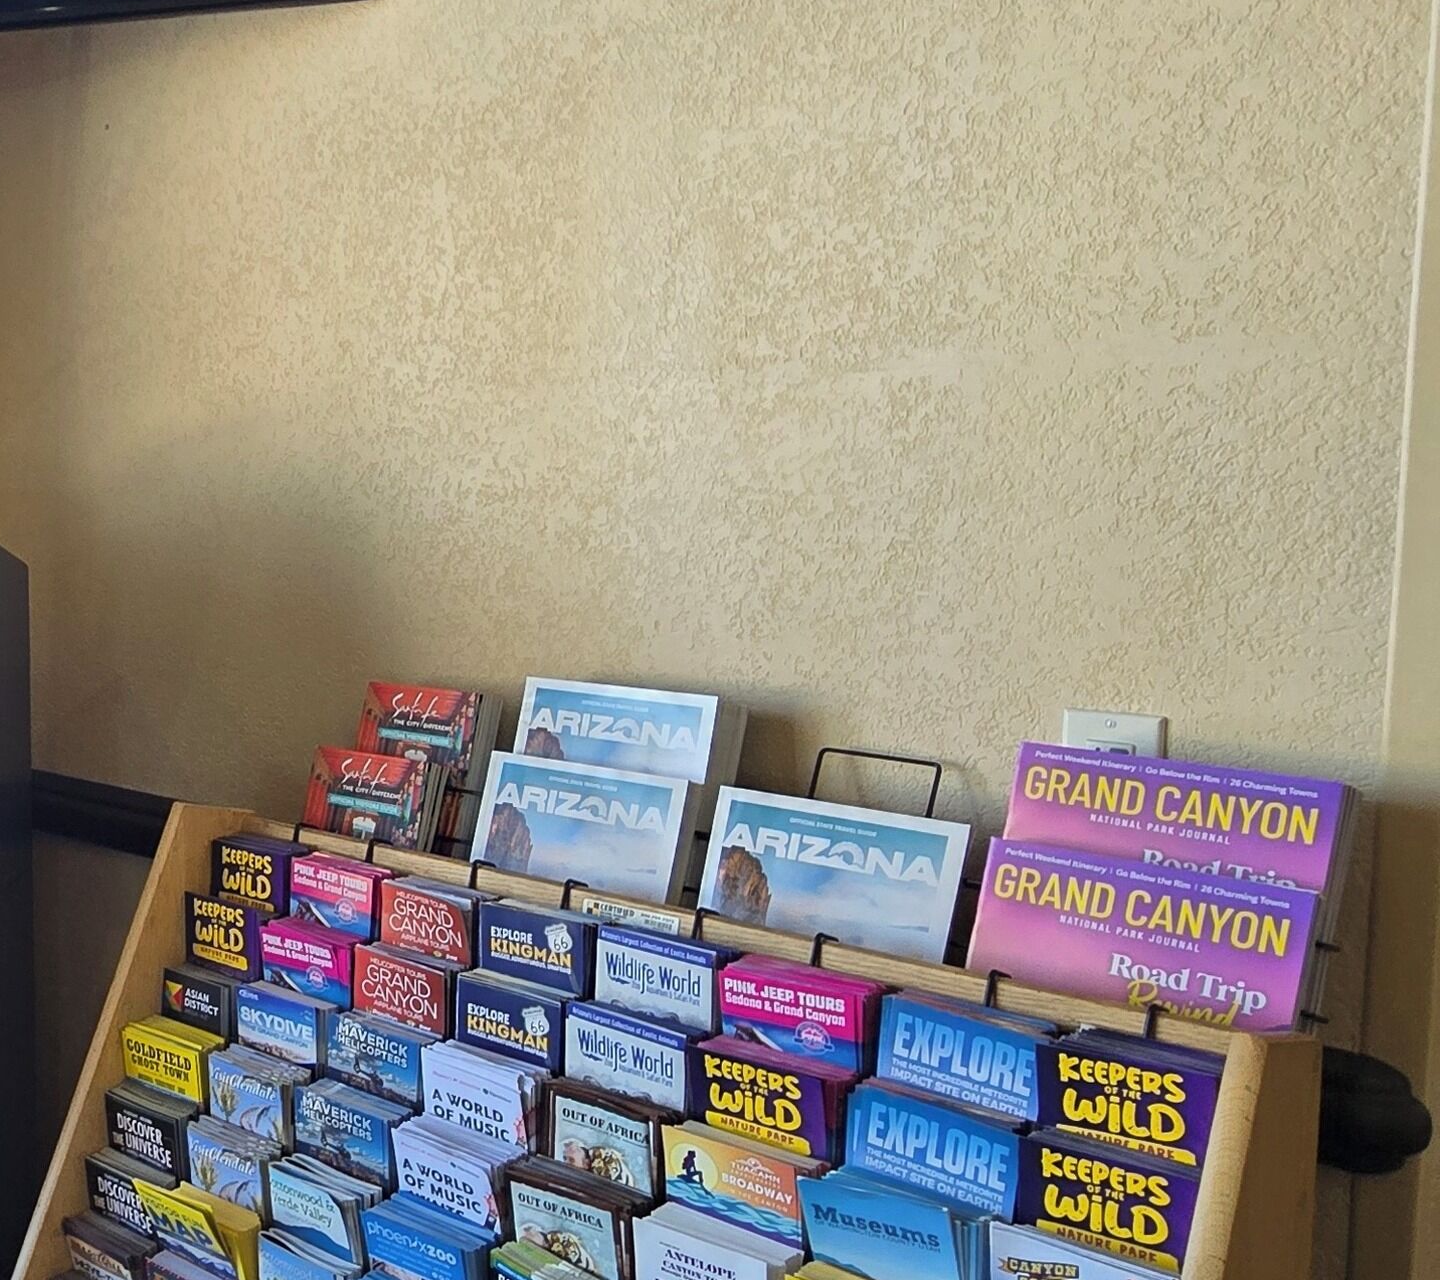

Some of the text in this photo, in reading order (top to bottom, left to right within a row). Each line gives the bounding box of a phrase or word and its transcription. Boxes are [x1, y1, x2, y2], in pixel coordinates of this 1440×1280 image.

[406, 720, 420, 728] CITY
[526, 706, 697, 750] ARIZONA
[1035, 750, 1136, 773] Perfect Weekend Itinerary
[1145, 765, 1220, 784] Go Below Rim
[1230, 777, 1318, 798] 26 Charming Towns
[496, 782, 664, 833] ARIZONA
[1024, 766, 1319, 845] GRAND CANYON
[1090, 814, 1231, 845] NATIONAL PARK JOURNAL
[222, 846, 272, 873] KEEPERS
[722, 823, 940, 885] ARIZONA
[317, 867, 341, 884] JEEP
[193, 898, 244, 927] KEEPERS
[394, 898, 453, 928] GRAND
[994, 863, 1291, 957] GRAND CANYON
[389, 914, 462, 948] CANYON
[491, 926, 569, 951] EXPLORE 66
[1060, 915, 1200, 952] NATIONAL PARK JOURNAL
[491, 938, 571, 970] KINGMAN
[367, 965, 431, 998] GRAND
[605, 951, 655, 992] Wildlife
[659, 967, 701, 997] World
[1109, 953, 1267, 1014] Road Trip
[184, 998, 219, 1017] DISTRICT
[185, 988, 209, 1002] ASIAN
[361, 980, 437, 1019] CANYON
[726, 993, 761, 1008] Sedona
[797, 992, 845, 1012] TOURS
[239, 1006, 313, 1039] SKYDIVE
[467, 1003, 509, 1025] EXPLORE
[338, 1017, 408, 1059] MAVERICK
[467, 1015, 548, 1051] KINGMAN
[127, 1039, 191, 1070] GOLDFIELD
[338, 1033, 407, 1069] HELICOPTERS
[631, 1047, 673, 1080] World
[893, 1012, 1035, 1097] EXPLORE
[162, 1066, 190, 1082] TOWN
[705, 1054, 801, 1100] KEEPERS
[908, 1063, 1028, 1108] MOST INCREDIBLE METEORITE
[1059, 1053, 1185, 1103] KEEPERS
[432, 1089, 503, 1122] A WORLD
[891, 1068, 1028, 1118] IMPACT SITE ON EARTH!
[117, 1112, 162, 1145] DISCOVER
[459, 1116, 510, 1142] MUSIC
[562, 1108, 650, 1144] OUT AFRICA
[126, 1125, 172, 1168] UNIVERSE
[867, 1101, 1009, 1191] EXPLORE
[416, 1162, 474, 1195] WORLD
[721, 1174, 792, 1205] BROADWAY
[1042, 1148, 1171, 1206] KEEPERS
[561, 1206, 603, 1228] AFRICA
[812, 1203, 940, 1248] Museums
[665, 1250, 736, 1280] ANTELOPE
[1010, 1260, 1077, 1277] CANYON
